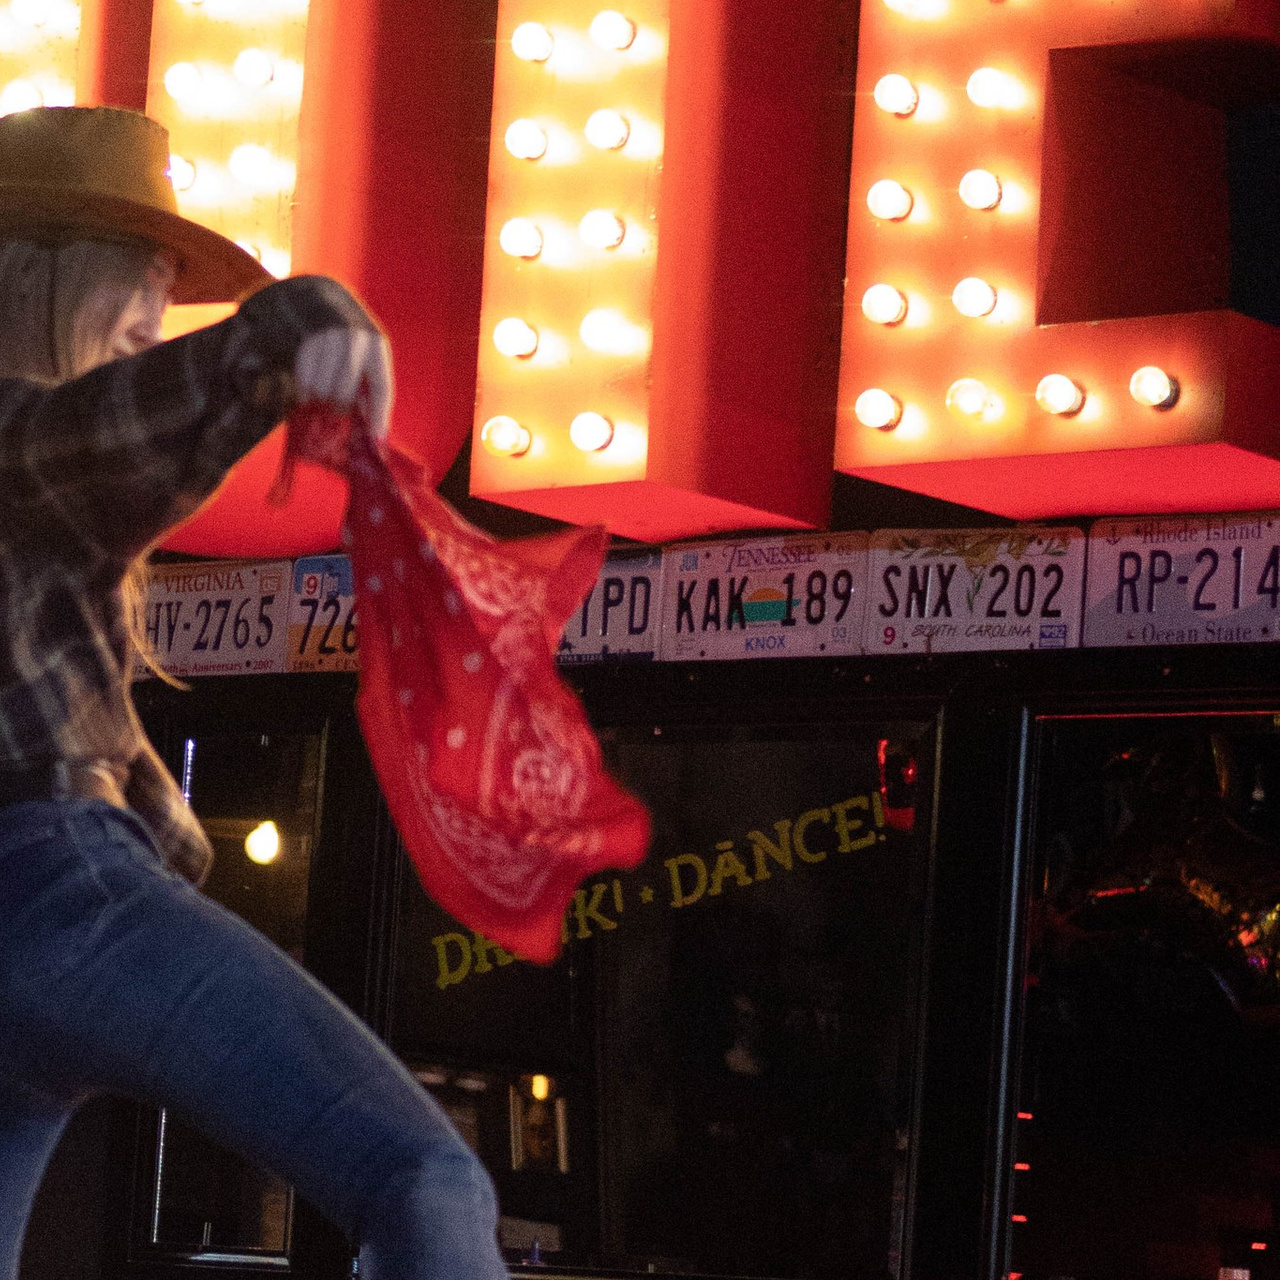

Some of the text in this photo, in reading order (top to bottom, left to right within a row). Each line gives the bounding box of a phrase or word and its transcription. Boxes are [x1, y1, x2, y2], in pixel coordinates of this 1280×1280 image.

[1204, 519, 1263, 540] Island
[722, 542, 817, 574] TENNESSEE
[164, 570, 245, 594] VIRGINIA
[305, 574, 319, 596] 9
[878, 563, 1064, 619] SNX 202
[677, 569, 853, 634] KAK 189
[965, 622, 1032, 638] CAROLINA
[1141, 621, 1252, 642] Ocean State
[745, 634, 786, 651] KNOX
[664, 790, 887, 909] DANCE!
